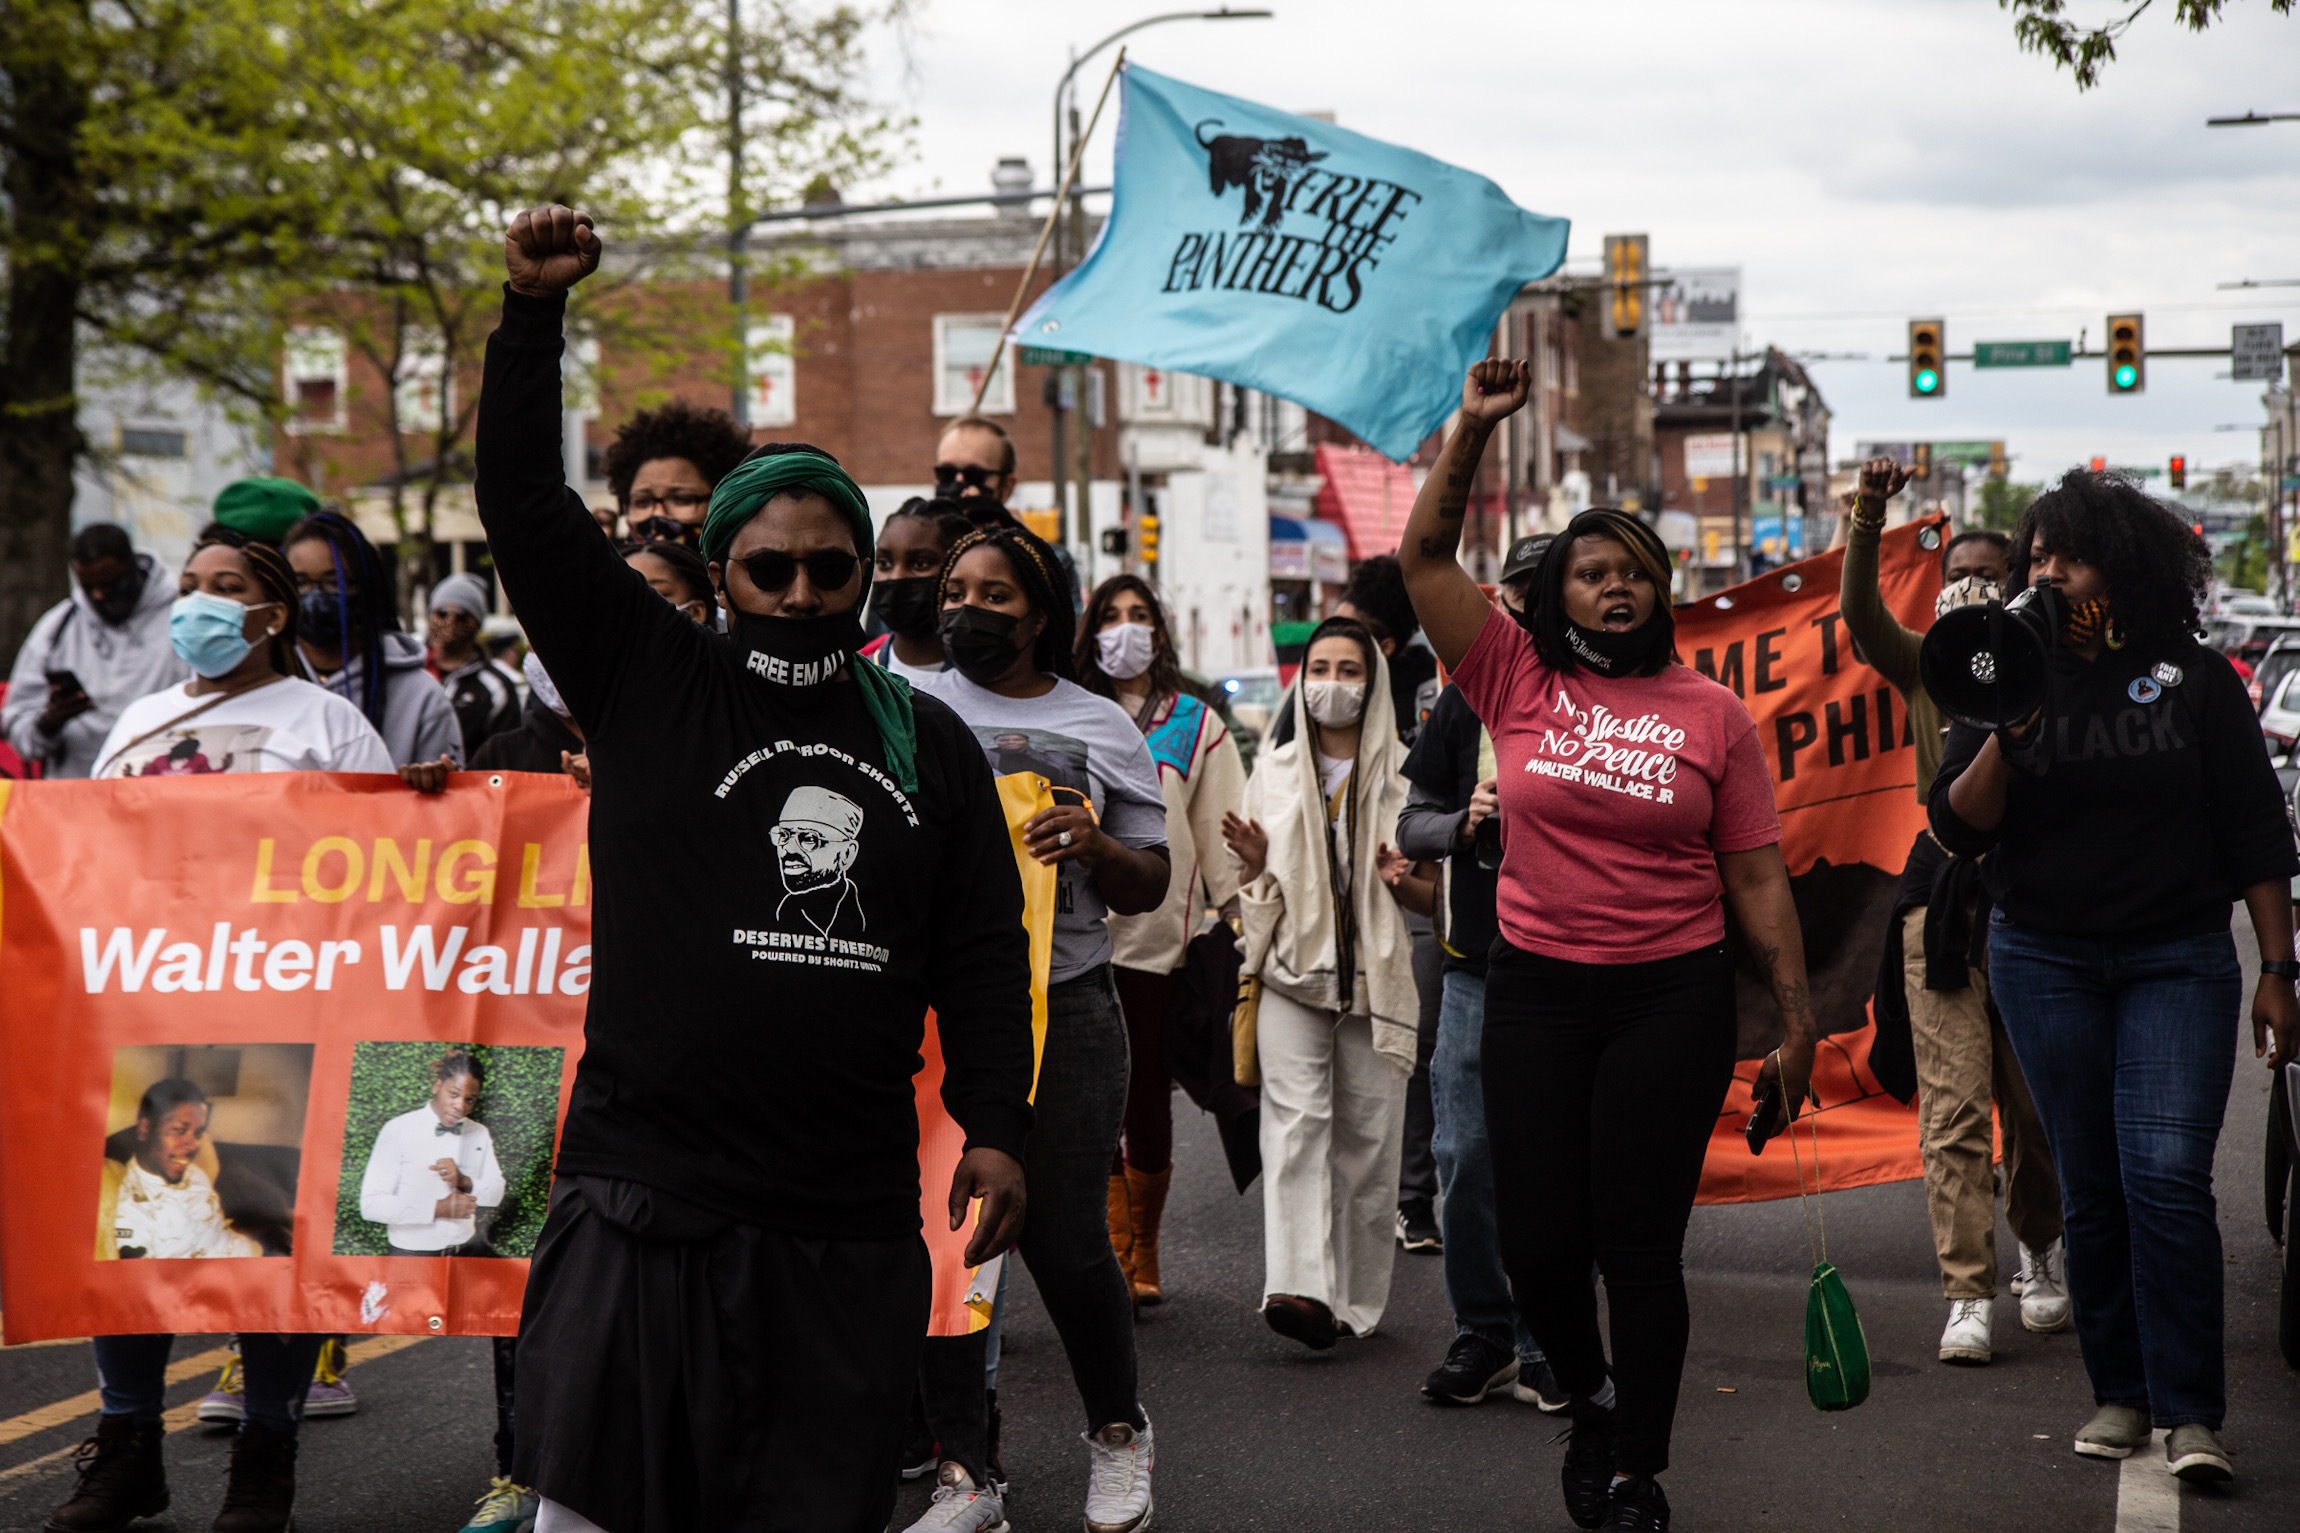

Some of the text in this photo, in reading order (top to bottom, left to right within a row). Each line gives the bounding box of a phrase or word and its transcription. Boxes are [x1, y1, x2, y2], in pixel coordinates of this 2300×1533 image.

[1284, 166, 1423, 244] FREE
[1322, 219, 1383, 271] THE
[1161, 230, 1363, 314] PANTHERS
[1565, 626, 1581, 646] No
[1811, 611, 1870, 675] T
[746, 649, 789, 685] FREE
[792, 660, 819, 687] EM
[2156, 670, 2175, 684] ANT
[2159, 662, 2178, 675] FREE
[1553, 690, 1686, 751] No Justice
[714, 747, 775, 799] RUSSELL
[1524, 758, 1675, 804] #WALTER WALLACE JR
[1537, 729, 1677, 785] No Peace
[251, 836, 498, 905] LONG
[80, 922, 362, 994] Walter
[733, 929, 890, 964] DESERVES FREEDOM
[752, 950, 882, 973] POWERED BY SHOATZ UNITY
